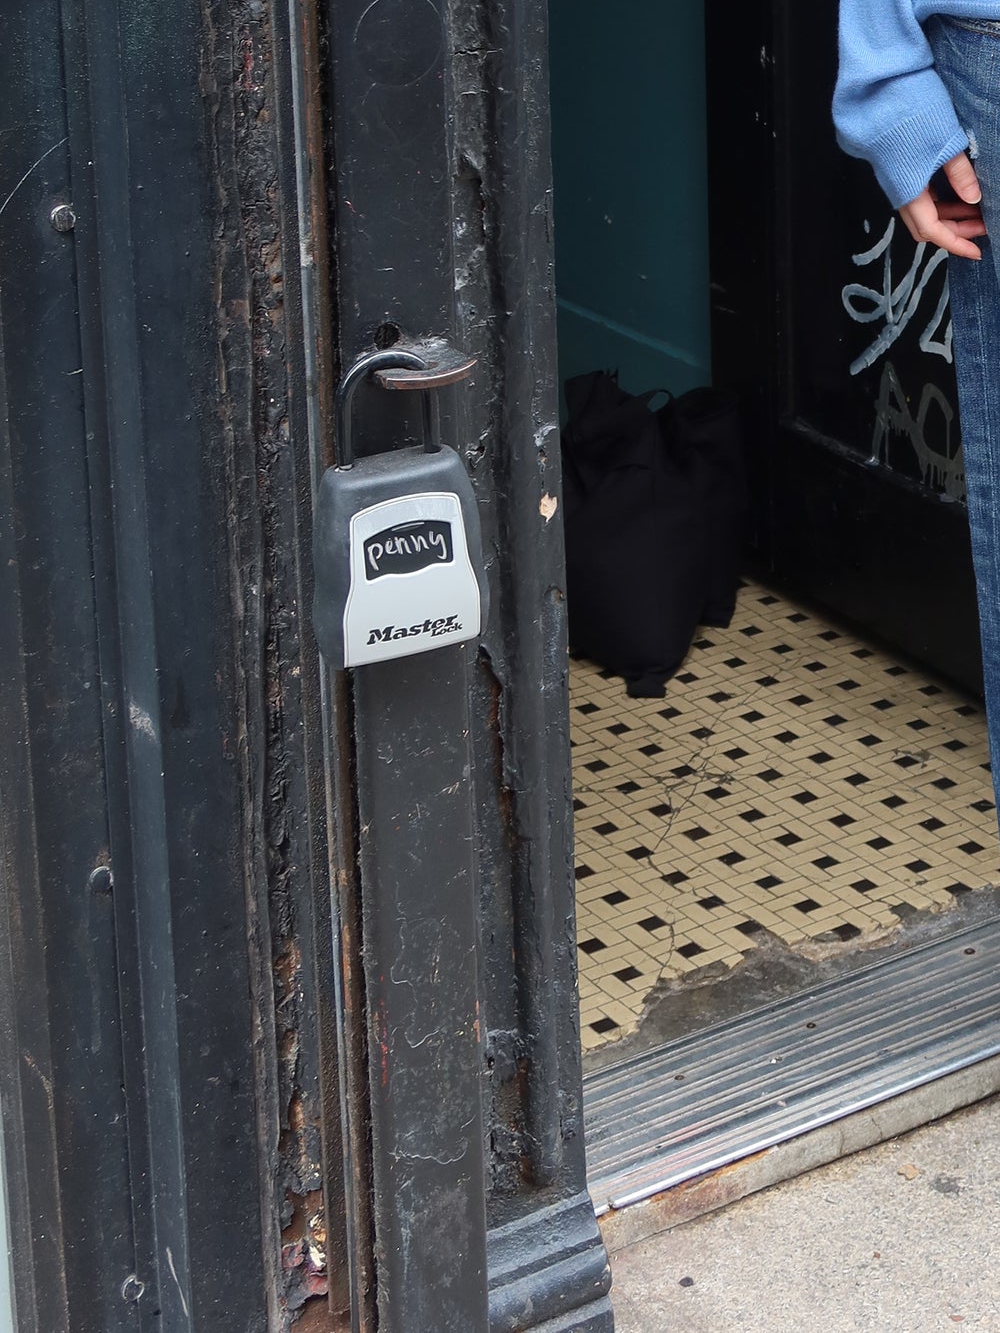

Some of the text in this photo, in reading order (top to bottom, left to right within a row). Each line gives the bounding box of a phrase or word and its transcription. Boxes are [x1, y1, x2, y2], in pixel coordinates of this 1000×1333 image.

[367, 530, 447, 571] penny
[366, 614, 458, 645] Master
[431, 623, 463, 638] Lock
